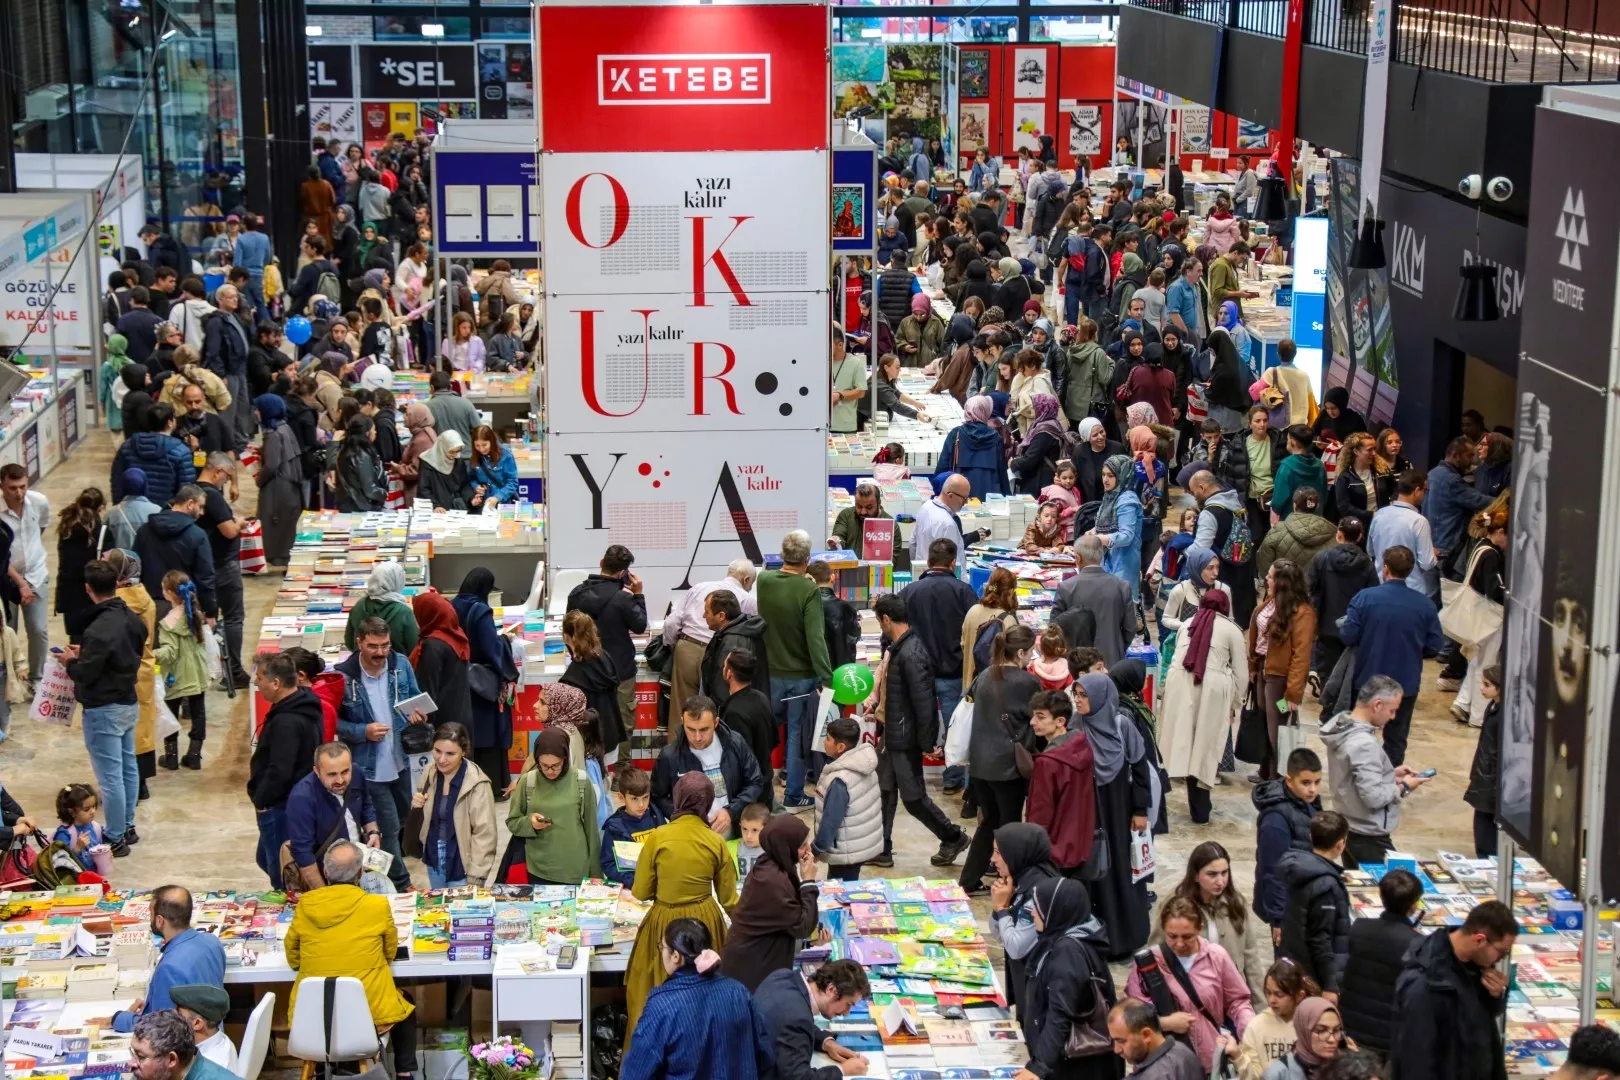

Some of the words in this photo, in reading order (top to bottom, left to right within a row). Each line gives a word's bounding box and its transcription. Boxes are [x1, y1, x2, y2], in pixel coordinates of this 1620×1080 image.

[610, 66, 759, 93] KETEBE
[696, 177, 731, 195] yazı
[684, 190, 727, 208] kalır
[1552, 278, 1584, 311] YEDİTEPE
[617, 334, 645, 348] yazı
[649, 325, 685, 341] kalır
[737, 464, 765, 478] yazı
[747, 476, 783, 491] kalır
[865, 531, 892, 542] %35
